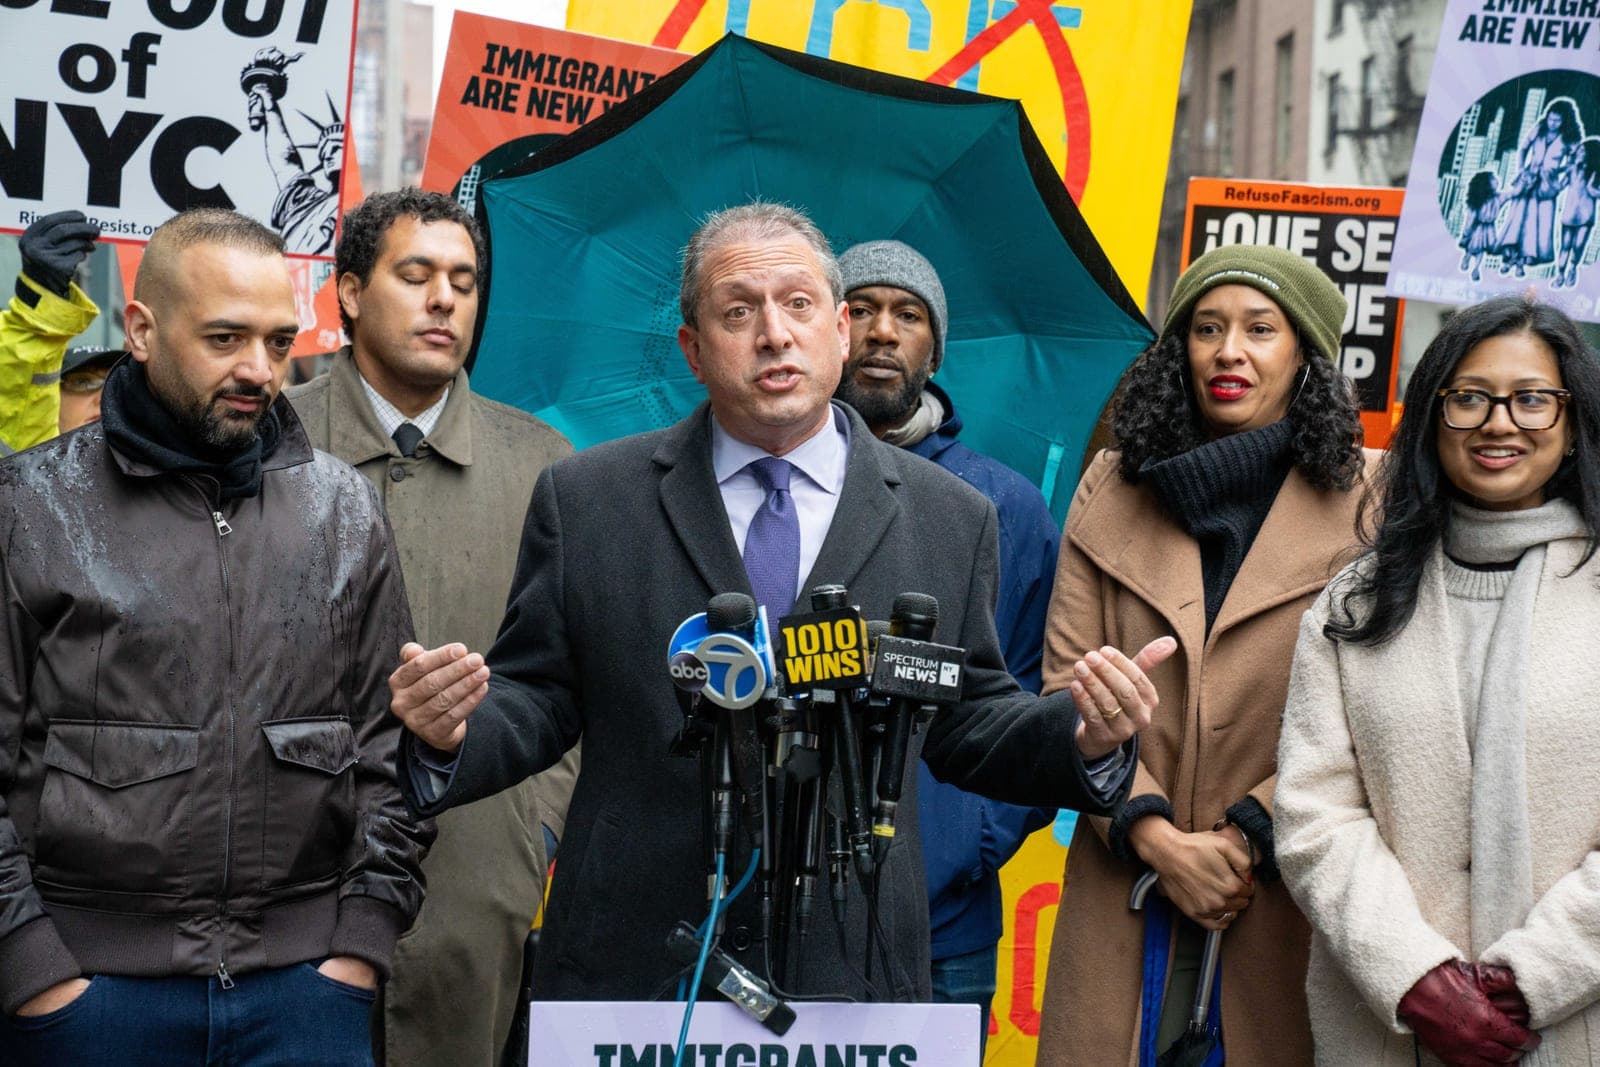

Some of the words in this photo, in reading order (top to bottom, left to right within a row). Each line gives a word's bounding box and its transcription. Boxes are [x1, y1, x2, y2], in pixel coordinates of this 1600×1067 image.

[1458, 14, 1517, 44] ARE
[1520, 18, 1591, 50] NEW
[58, 32, 162, 99] of
[481, 42, 667, 99] IMMIGRANT
[460, 75, 520, 113] ARE
[525, 86, 594, 125] NEW
[1224, 186, 1381, 210] RefuseFascism.org
[1331, 218, 1396, 273] SE
[782, 618, 858, 658] 1010
[670, 661, 707, 680] abc
[785, 649, 861, 684] WINS
[883, 652, 939, 669] SPECTRUM
[894, 664, 937, 684] NEWS
[950, 675, 957, 684] 1
